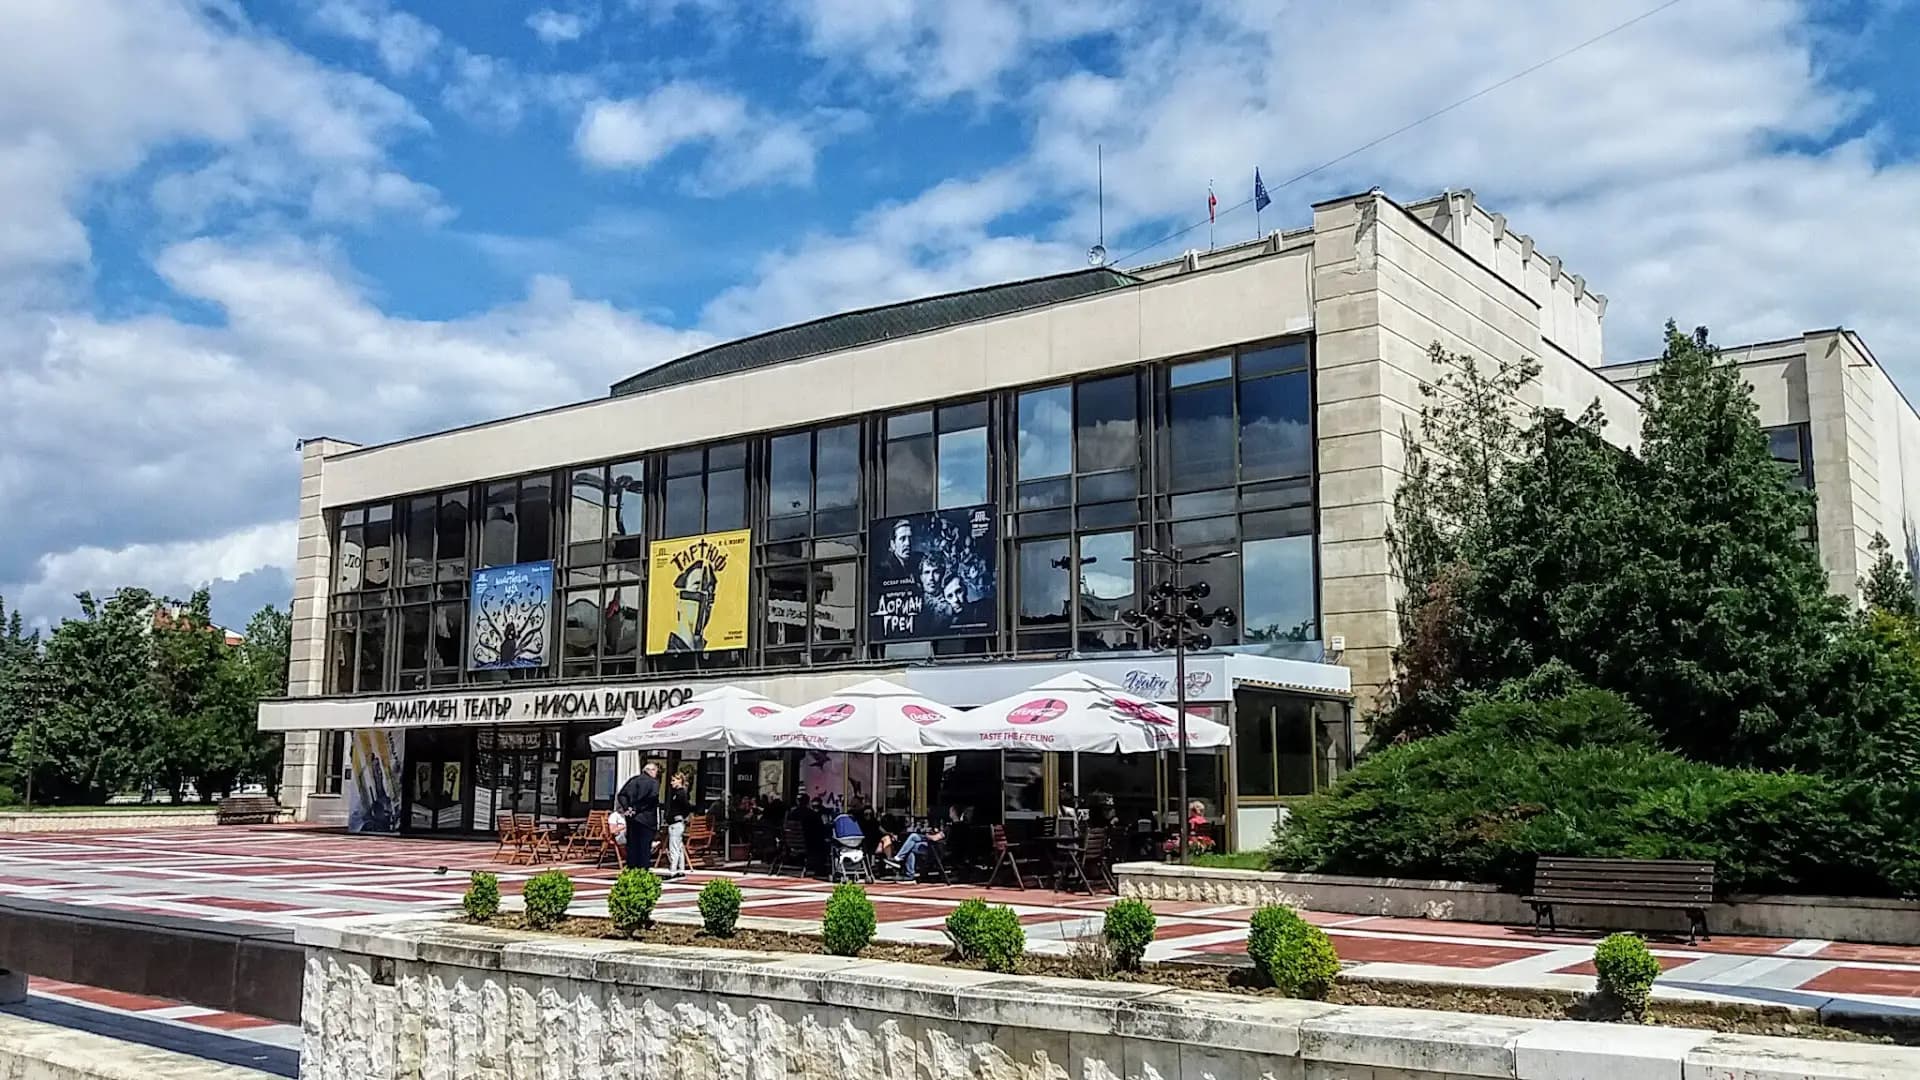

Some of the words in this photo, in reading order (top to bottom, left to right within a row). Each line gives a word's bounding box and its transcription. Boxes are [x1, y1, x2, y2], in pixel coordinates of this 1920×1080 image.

[869, 594, 922, 616] ДОРИАН
[374, 698, 458, 722] ДРАМАТИЧЕН
[464, 696, 512, 718] ТЕАТЪР
[534, 692, 599, 715] НИКОЛА
[605, 687, 693, 714] ВАПЦАРОВ
[979, 732, 1003, 741] TASTE
[1003, 732, 1018, 741] THE
[1019, 733, 1055, 743] FEELING
